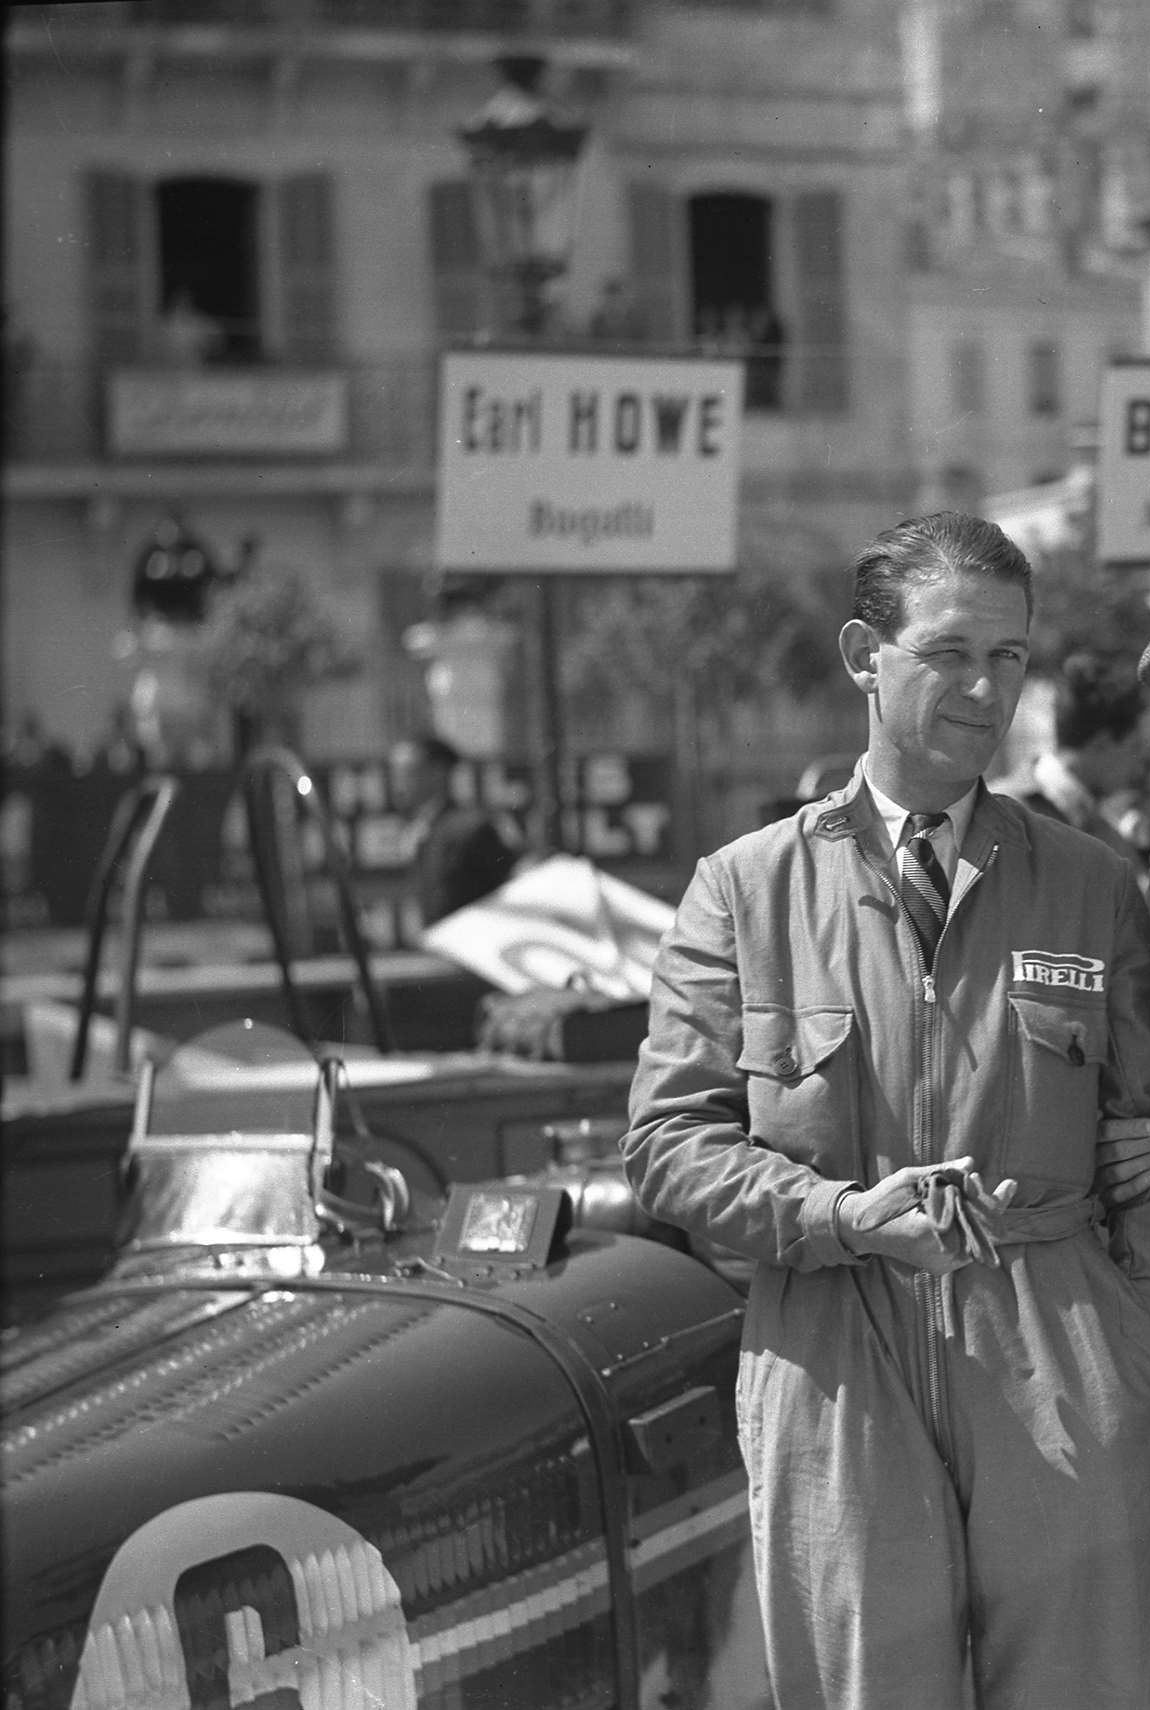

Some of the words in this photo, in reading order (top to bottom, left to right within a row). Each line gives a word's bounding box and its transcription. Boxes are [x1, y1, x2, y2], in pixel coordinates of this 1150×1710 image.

[464, 387, 542, 455] Earl
[569, 392, 721, 456] HOWE
[530, 501, 653, 546] Bugatti
[1010, 951, 1105, 992] PIRELLI
